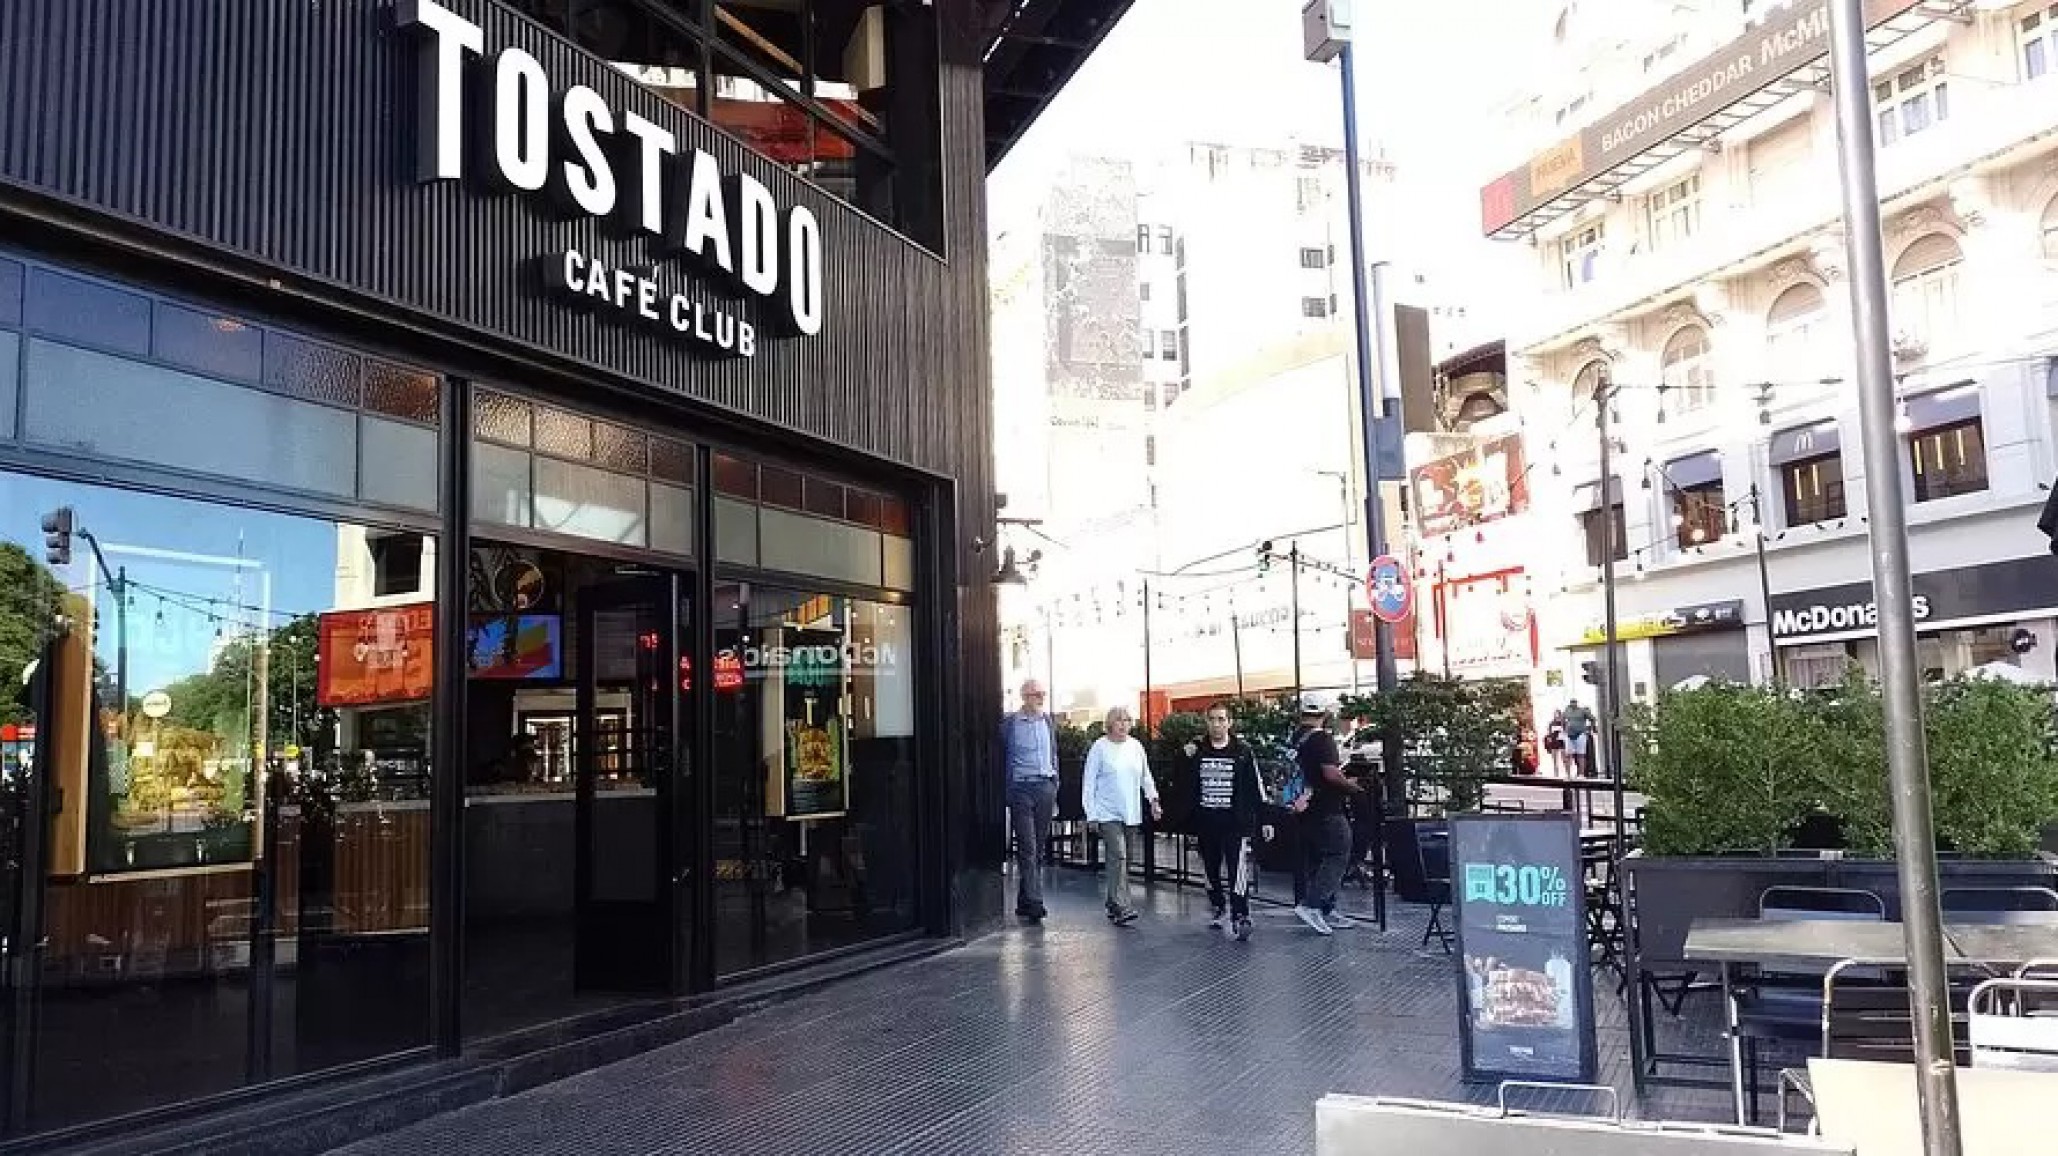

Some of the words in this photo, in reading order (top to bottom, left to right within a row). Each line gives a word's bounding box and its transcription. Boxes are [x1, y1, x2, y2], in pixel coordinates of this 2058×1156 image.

[1601, 105, 1660, 152] BACON
[1662, 55, 1754, 119] CHEDDAR
[417, 0, 822, 336] TOSTADO
[564, 249, 660, 321] CAFÉ
[671, 294, 755, 357] CLUB
[1496, 864, 1567, 905] 30%
[1541, 891, 1567, 907] OFF
